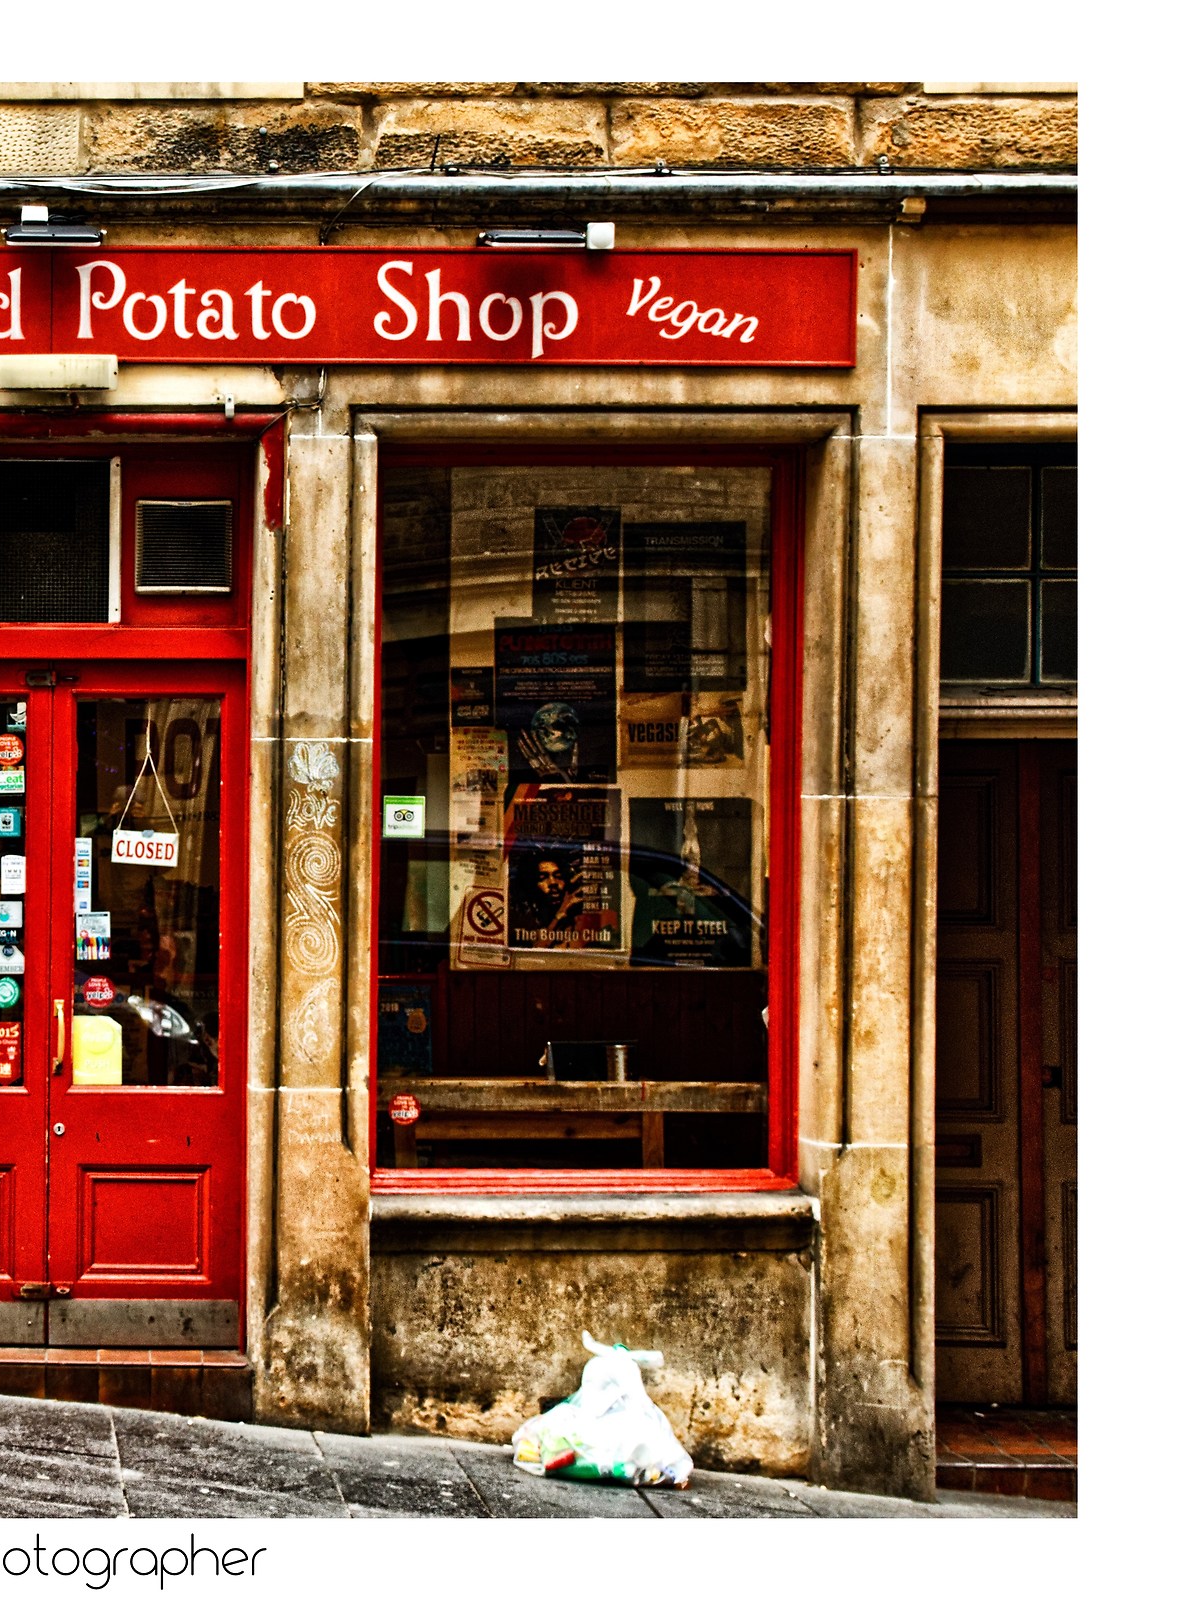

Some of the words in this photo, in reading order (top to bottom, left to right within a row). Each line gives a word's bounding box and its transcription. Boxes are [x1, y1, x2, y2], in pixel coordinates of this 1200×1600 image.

[75, 260, 317, 341] Potato
[373, 260, 579, 359] Shop
[626, 275, 760, 344] Vegan
[643, 535, 724, 546] TRANSMISSION
[6, 774, 23, 783] eat
[116, 839, 175, 861] CLOSED
[652, 920, 681, 935] KEEP
[683, 920, 694, 935] IT
[696, 920, 728, 935] STEEL
[514, 928, 537, 941] The
[540, 929, 579, 943] Bongo
[582, 928, 611, 941] Club
[86, 990, 106, 999] yelp
